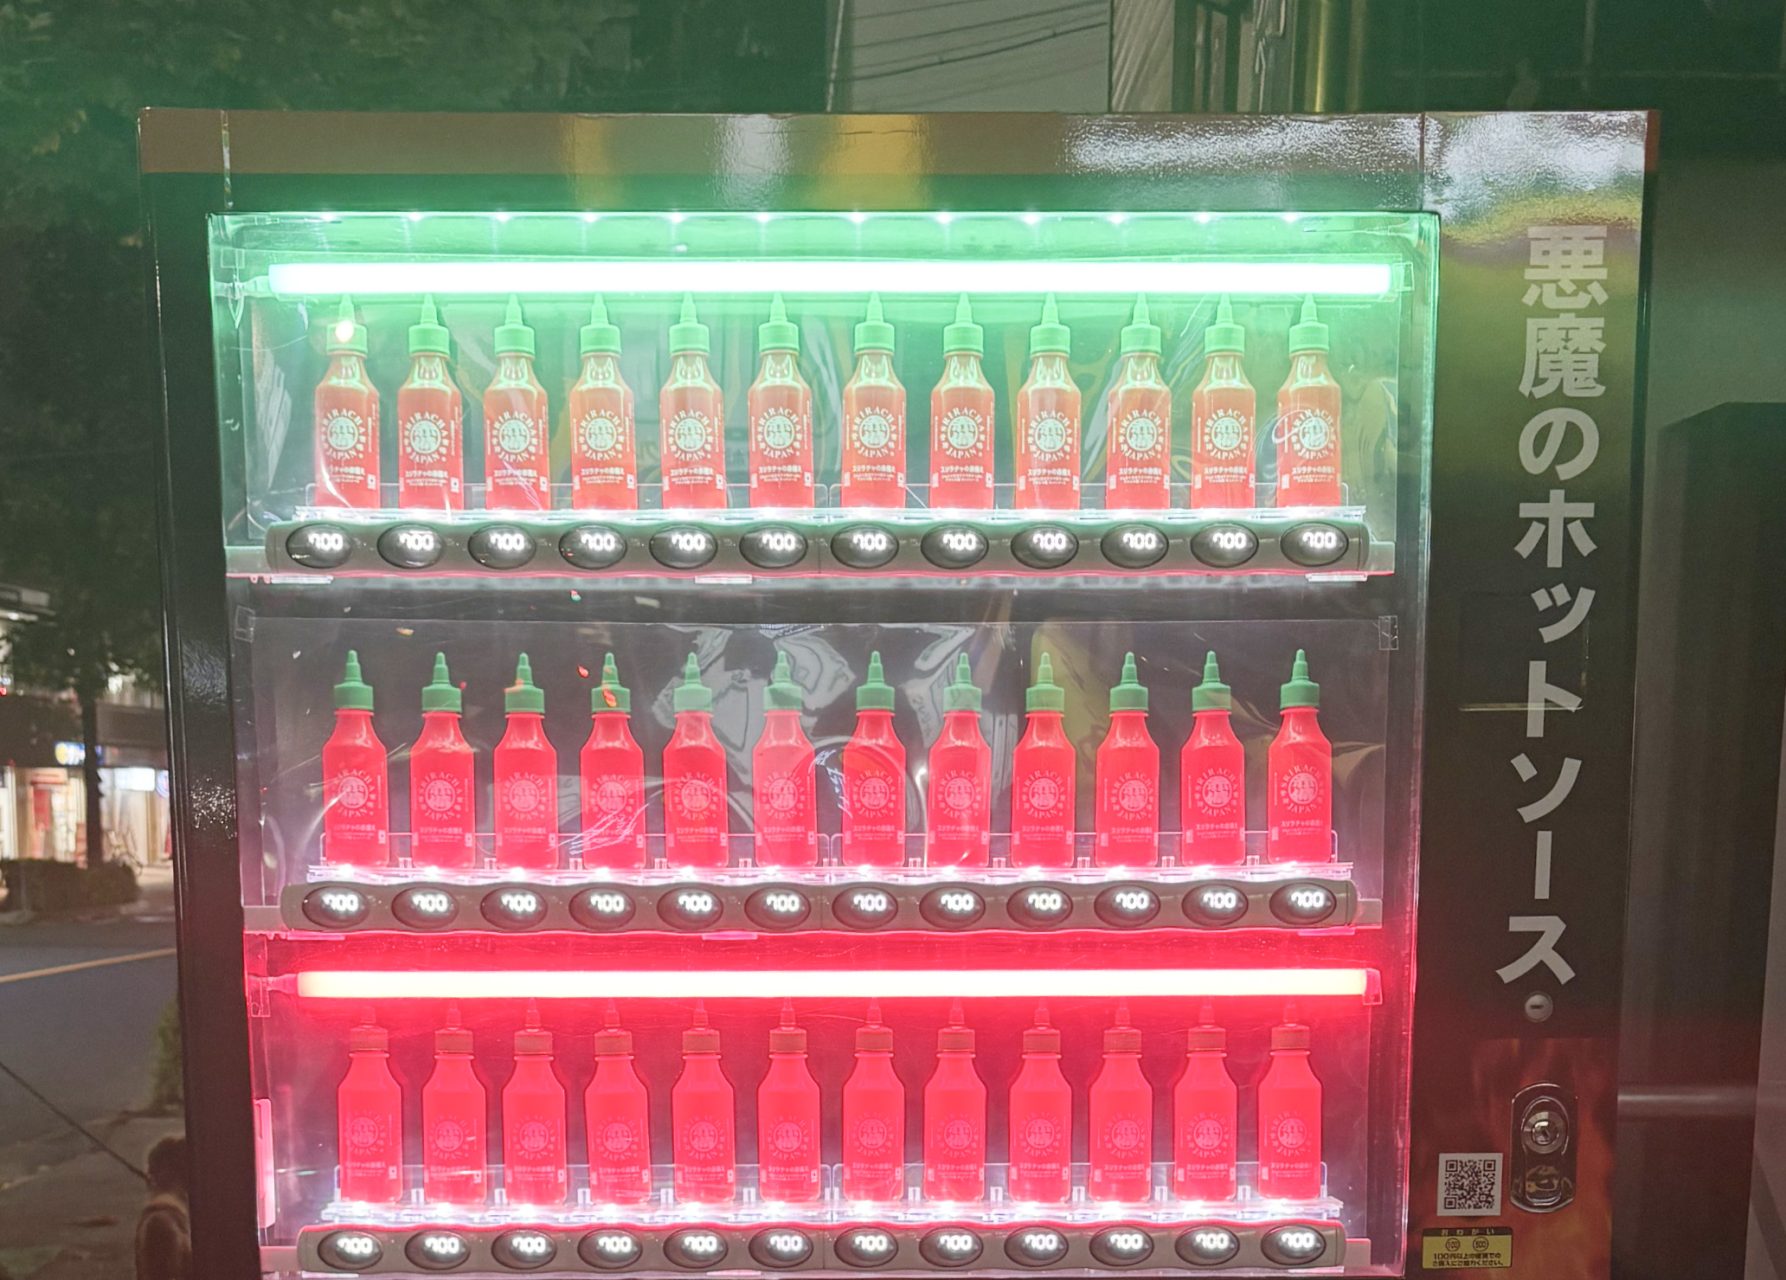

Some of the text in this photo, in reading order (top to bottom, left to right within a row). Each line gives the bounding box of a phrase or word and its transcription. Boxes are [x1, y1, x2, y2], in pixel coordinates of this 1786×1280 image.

[1495, 225, 1609, 986] 悪魔のホットソース
